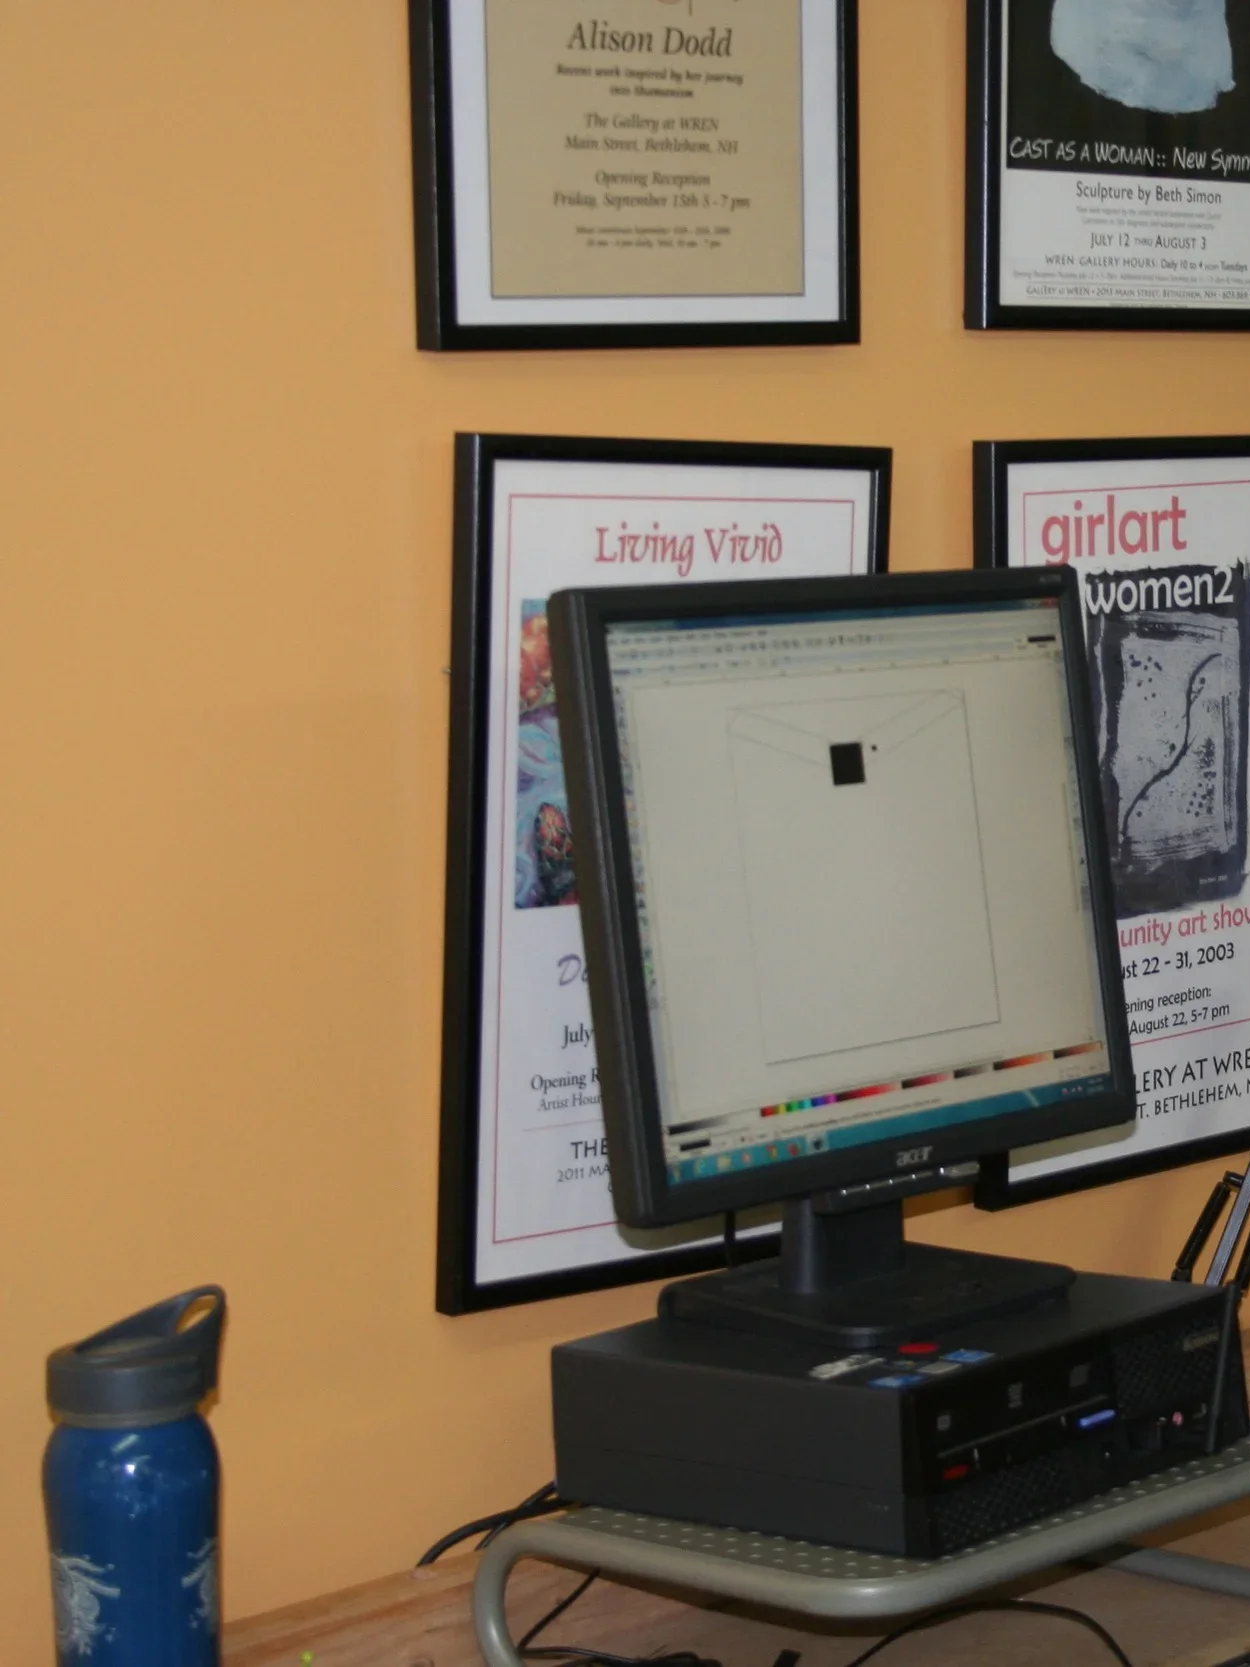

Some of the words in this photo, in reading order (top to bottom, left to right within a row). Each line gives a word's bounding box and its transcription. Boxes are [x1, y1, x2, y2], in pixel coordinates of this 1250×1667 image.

[566, 19, 653, 53] Alison
[663, 26, 733, 57] Dodd
[584, 112, 608, 129] The
[612, 113, 659, 134] Gallery
[661, 118, 675, 131] at
[679, 116, 719, 132] WREN
[565, 135, 599, 151] Main
[717, 139, 739, 155] NH
[1009, 136, 1054, 160] CAST
[1055, 139, 1077, 161] AS
[1079, 142, 1091, 163] A
[1172, 145, 1206, 170] New
[595, 169, 648, 189] Opening
[651, 170, 711, 190] Reception
[602, 191, 668, 212] September
[673, 193, 699, 208] 15th
[731, 197, 751, 212] pm
[1076, 180, 1133, 202] Sculpture
[1137, 183, 1151, 205] by
[1155, 185, 1182, 203] Beth
[1186, 186, 1222, 204] Simon
[1090, 232, 1114, 250] JULY
[1118, 232, 1130, 248] 12
[1154, 234, 1197, 250] AUGUST
[1201, 236, 1207, 250] 3
[1045, 254, 1075, 267] WREN
[1079, 255, 1119, 269] GALLERY
[1160, 258, 1178, 272] Daily
[1042, 494, 1187, 566] girlart
[595, 521, 695, 577] Living
[704, 522, 782, 565] Vivid
[1084, 568, 1234, 615] women2
[1121, 918, 1171, 947] unity
[1178, 910, 1206, 936] art
[1142, 956, 1160, 975] 22
[1176, 950, 1192, 969] 31,
[1197, 942, 1234, 965] 2003
[1125, 998, 1154, 1014] ening
[1157, 987, 1212, 1007] reception:
[1130, 1015, 1168, 1035] August
[1172, 1012, 1187, 1026] 22,
[1191, 1007, 1208, 1022] 5-7
[1211, 1004, 1229, 1020] pm
[560, 1022, 591, 1049] July
[1182, 1057, 1208, 1083] AT
[531, 1071, 587, 1095] Opening
[537, 1096, 569, 1112] Artist
[1155, 1082, 1242, 1115] BETHLEHEM,
[570, 1138, 609, 1159] THE
[896, 1145, 932, 1166] acer
[557, 1167, 584, 1182] 2011
[588, 1163, 610, 1178] MA
